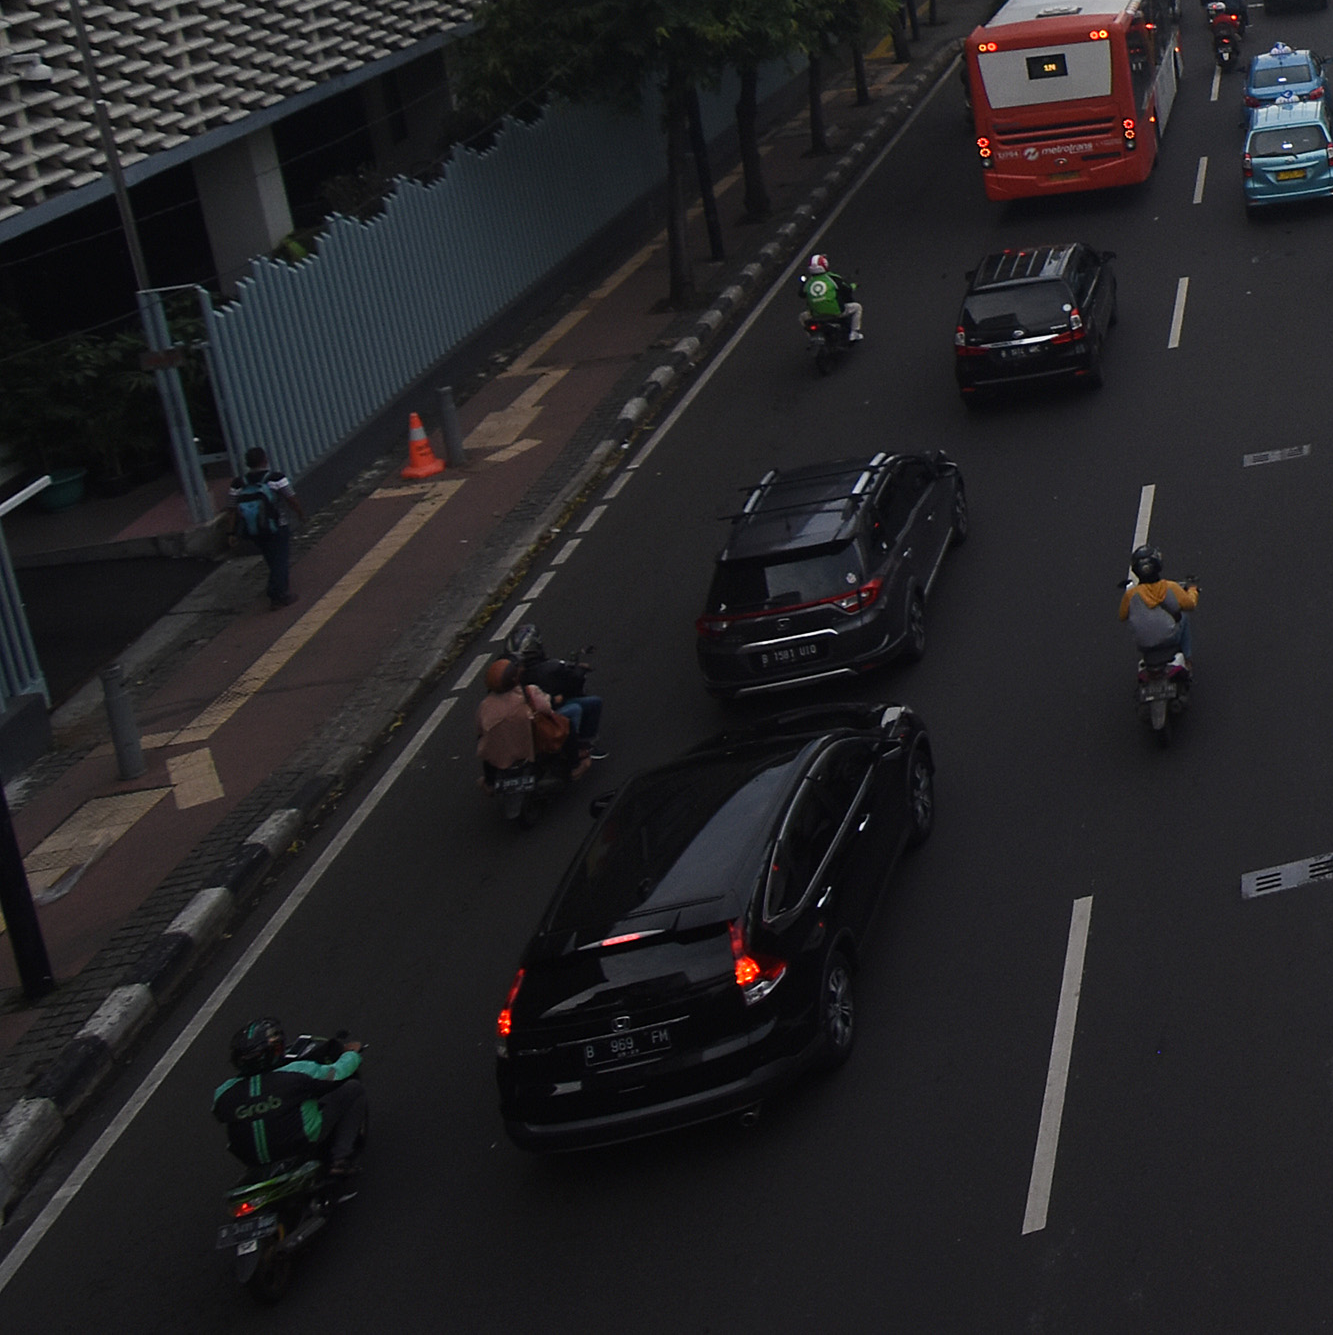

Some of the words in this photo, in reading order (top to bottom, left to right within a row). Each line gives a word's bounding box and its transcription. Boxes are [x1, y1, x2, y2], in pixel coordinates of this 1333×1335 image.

[1042, 142, 1093, 155] metrotrans
[586, 1044, 595, 1059] B
[611, 1036, 634, 1053] 969
[651, 1030, 670, 1044] FM
[235, 1095, 283, 1120] Grab
